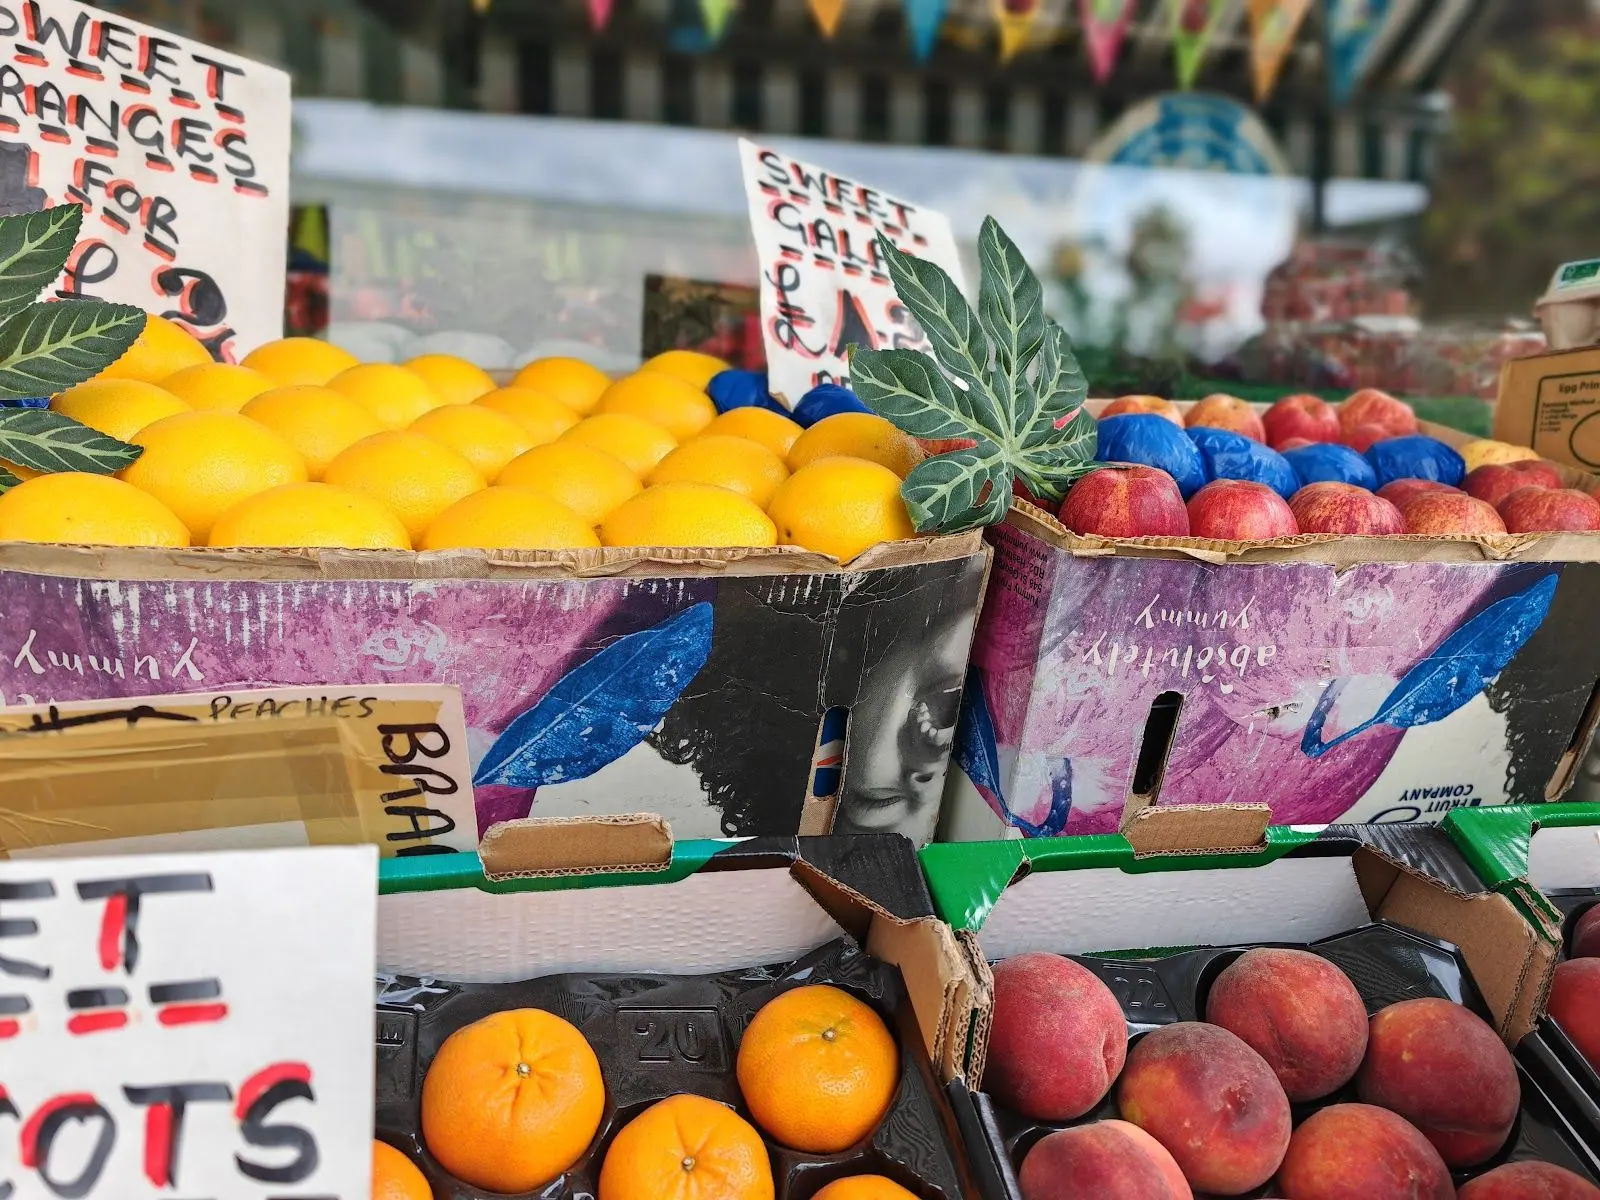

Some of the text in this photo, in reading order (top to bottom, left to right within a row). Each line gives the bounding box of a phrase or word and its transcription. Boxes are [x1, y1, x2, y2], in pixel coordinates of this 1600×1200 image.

[73, 156, 180, 245] FOR
[1558, 382, 1578, 394] Egg
[1014, 583, 1039, 608] Yummy
[1083, 631, 1277, 679] absolutely
[209, 695, 378, 722] PEACHES
[1399, 784, 1475, 802] COMPANY
[635, 1021, 706, 1065] 20
